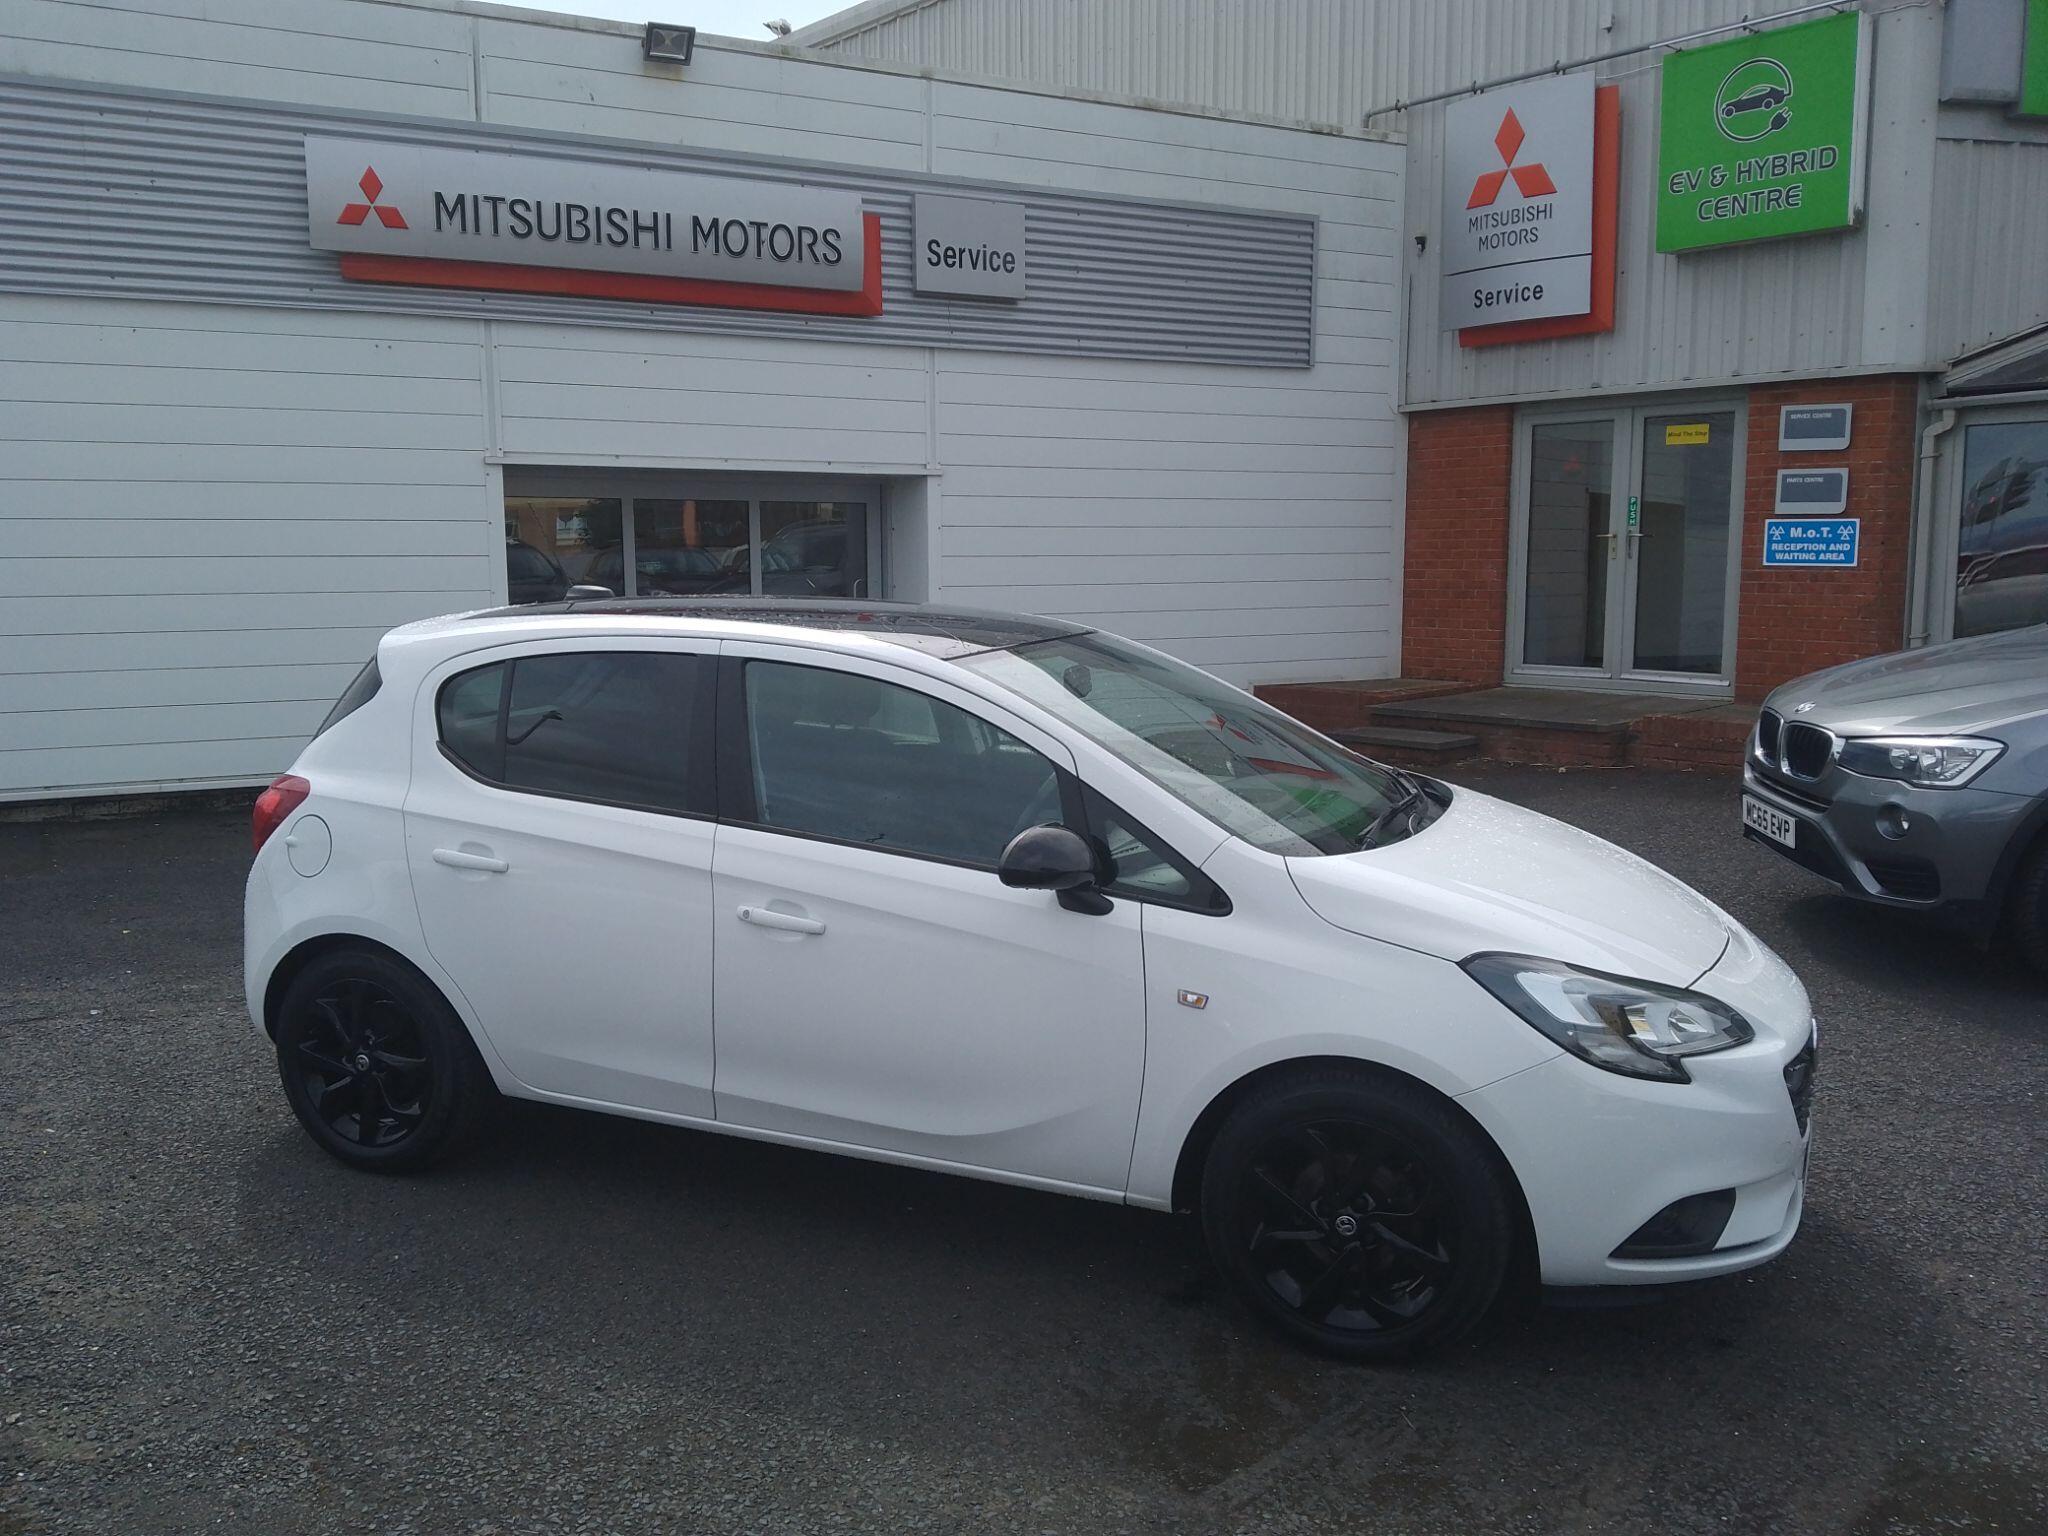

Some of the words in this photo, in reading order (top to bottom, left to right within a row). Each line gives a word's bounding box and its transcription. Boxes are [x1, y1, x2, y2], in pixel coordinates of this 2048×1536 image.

[1669, 168, 1704, 195] EV
[1708, 166, 1729, 187] &
[1736, 145, 1838, 184] HYBRID
[1697, 184, 1802, 222] CENTRE
[433, 190, 673, 252] MITSUBISHI
[691, 215, 842, 266] MOTORS
[1468, 203, 1553, 234] MITSUBISHI
[1478, 227, 1539, 252] MOTORS
[926, 239, 1017, 275] Service
[1473, 282, 1544, 309] Service
[1629, 497, 1637, 524] PUSH
[1790, 527, 1832, 538] M.o.T.
[1772, 543, 1826, 551] RECEPTION
[1828, 543, 1850, 551] AND
[1775, 552, 1816, 561] WAITING
[1818, 552, 1845, 560] AREA
